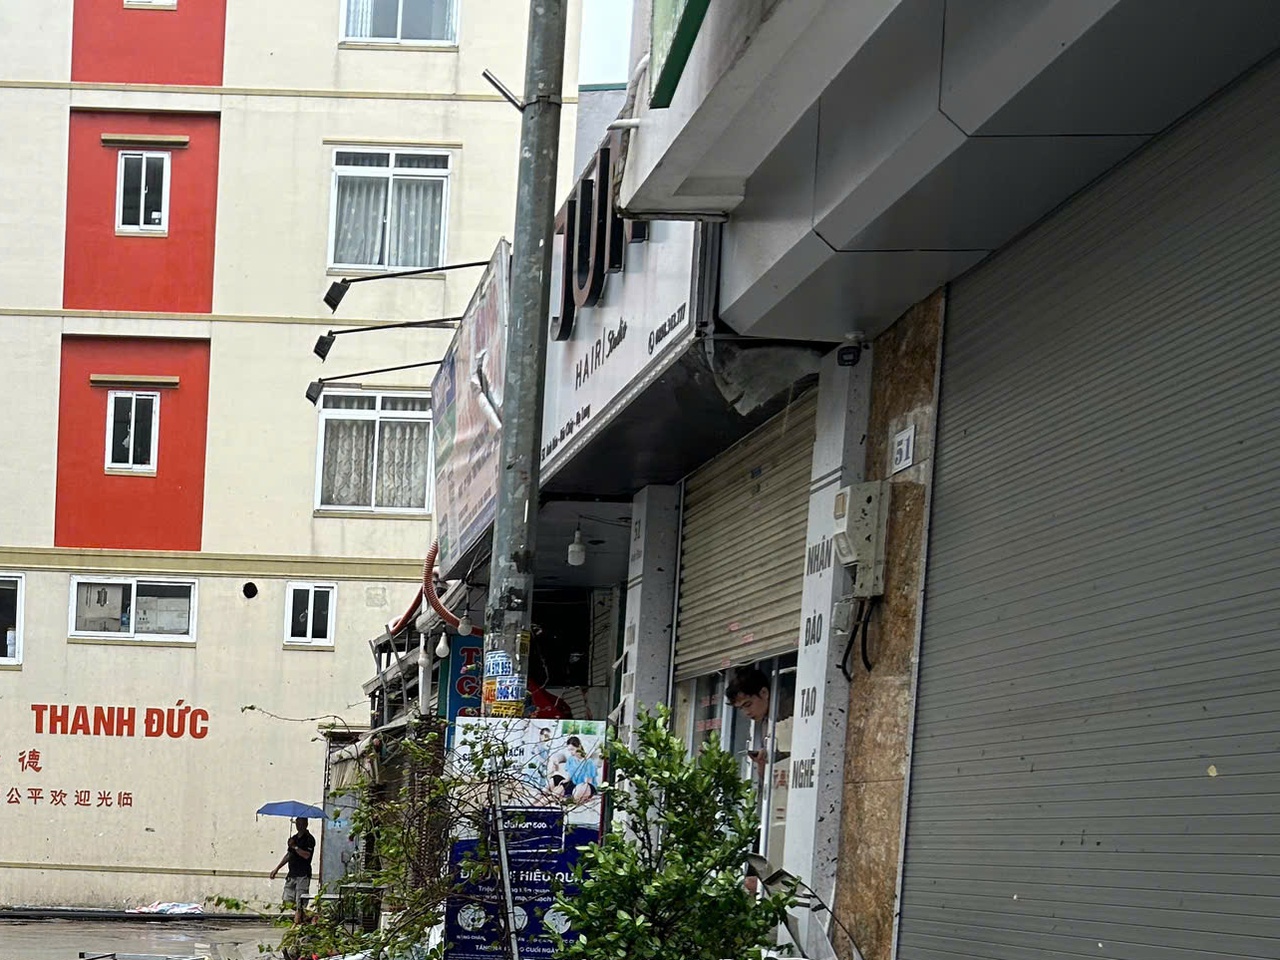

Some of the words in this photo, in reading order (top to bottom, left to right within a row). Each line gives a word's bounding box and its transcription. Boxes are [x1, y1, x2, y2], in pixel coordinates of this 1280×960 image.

[575, 338, 602, 391] HAIR
[894, 434, 911, 466] 51
[806, 535, 833, 578] NHẬN
[31, 704, 137, 738] THANH
[144, 699, 210, 740] ĐỨC
[800, 686, 817, 724] TẠO
